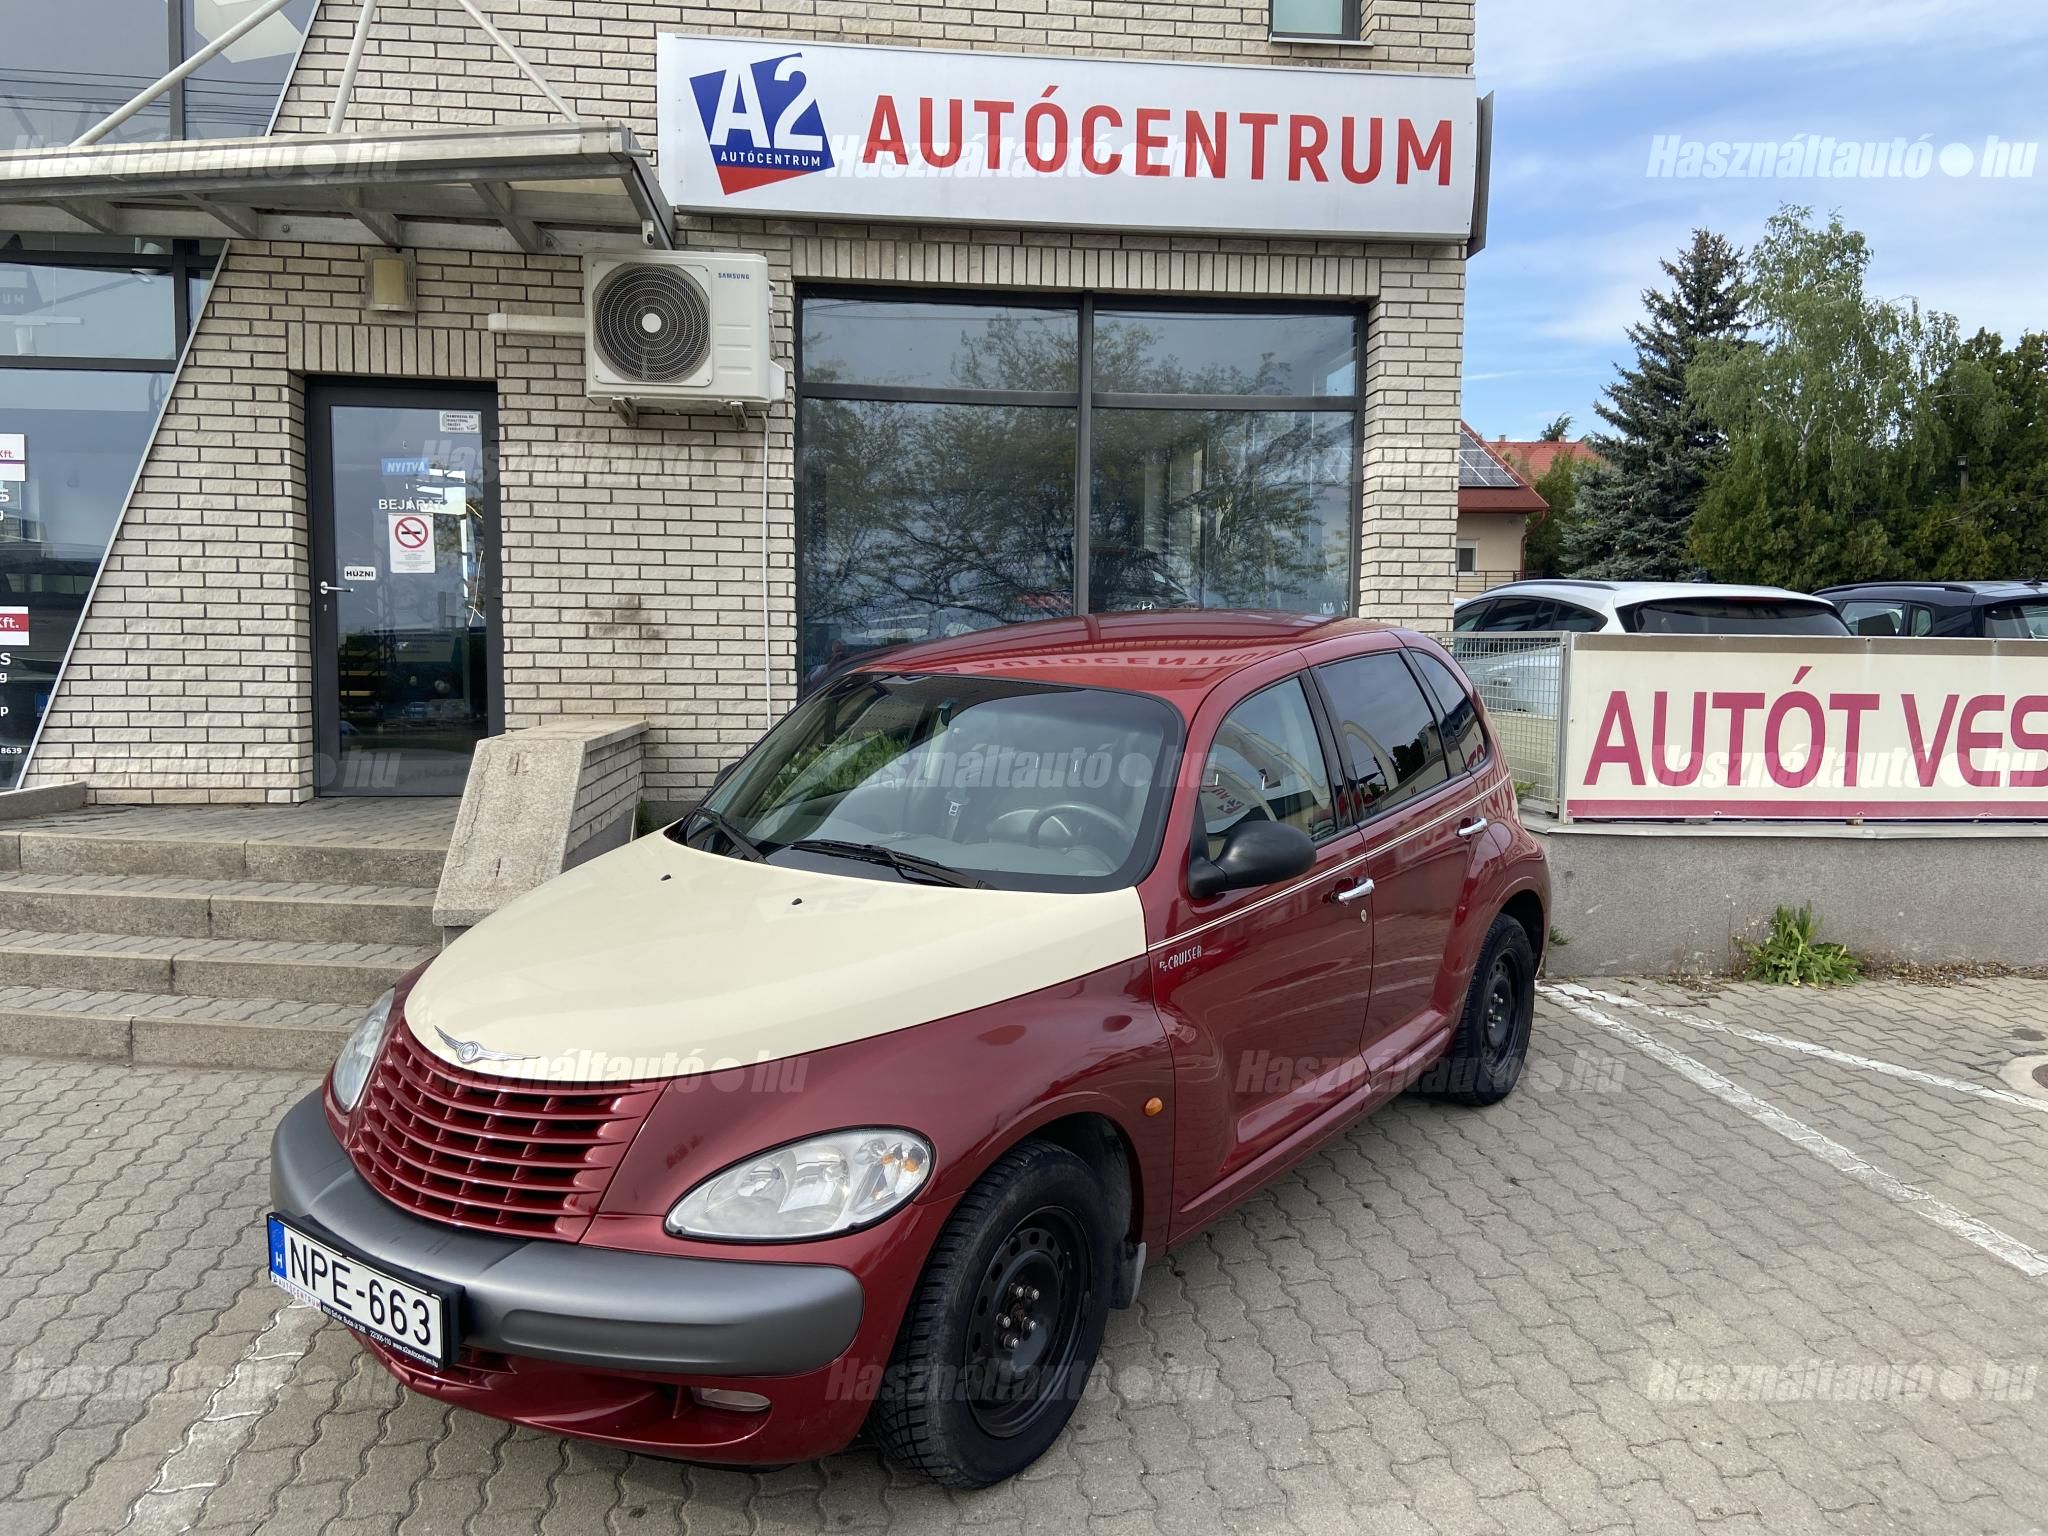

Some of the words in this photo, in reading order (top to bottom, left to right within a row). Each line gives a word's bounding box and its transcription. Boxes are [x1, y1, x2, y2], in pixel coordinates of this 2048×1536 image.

[710, 55, 823, 152] A2
[864, 85, 1453, 187] AUTÓCENTRUM
[720, 150, 821, 167] AUTÓCENTRUM
[717, 271, 751, 281] SAMSUNG
[387, 461, 426, 474] NYITVA
[378, 497, 444, 511] BEJÁRAT
[345, 569, 375, 578] HÚZNI
[1583, 666, 1880, 788] AUTÓT
[1901, 693, 2048, 788] VES
[1167, 944, 1203, 970] CRUISER
[275, 1250, 284, 1270] H
[289, 1236, 432, 1346] NPE-663
